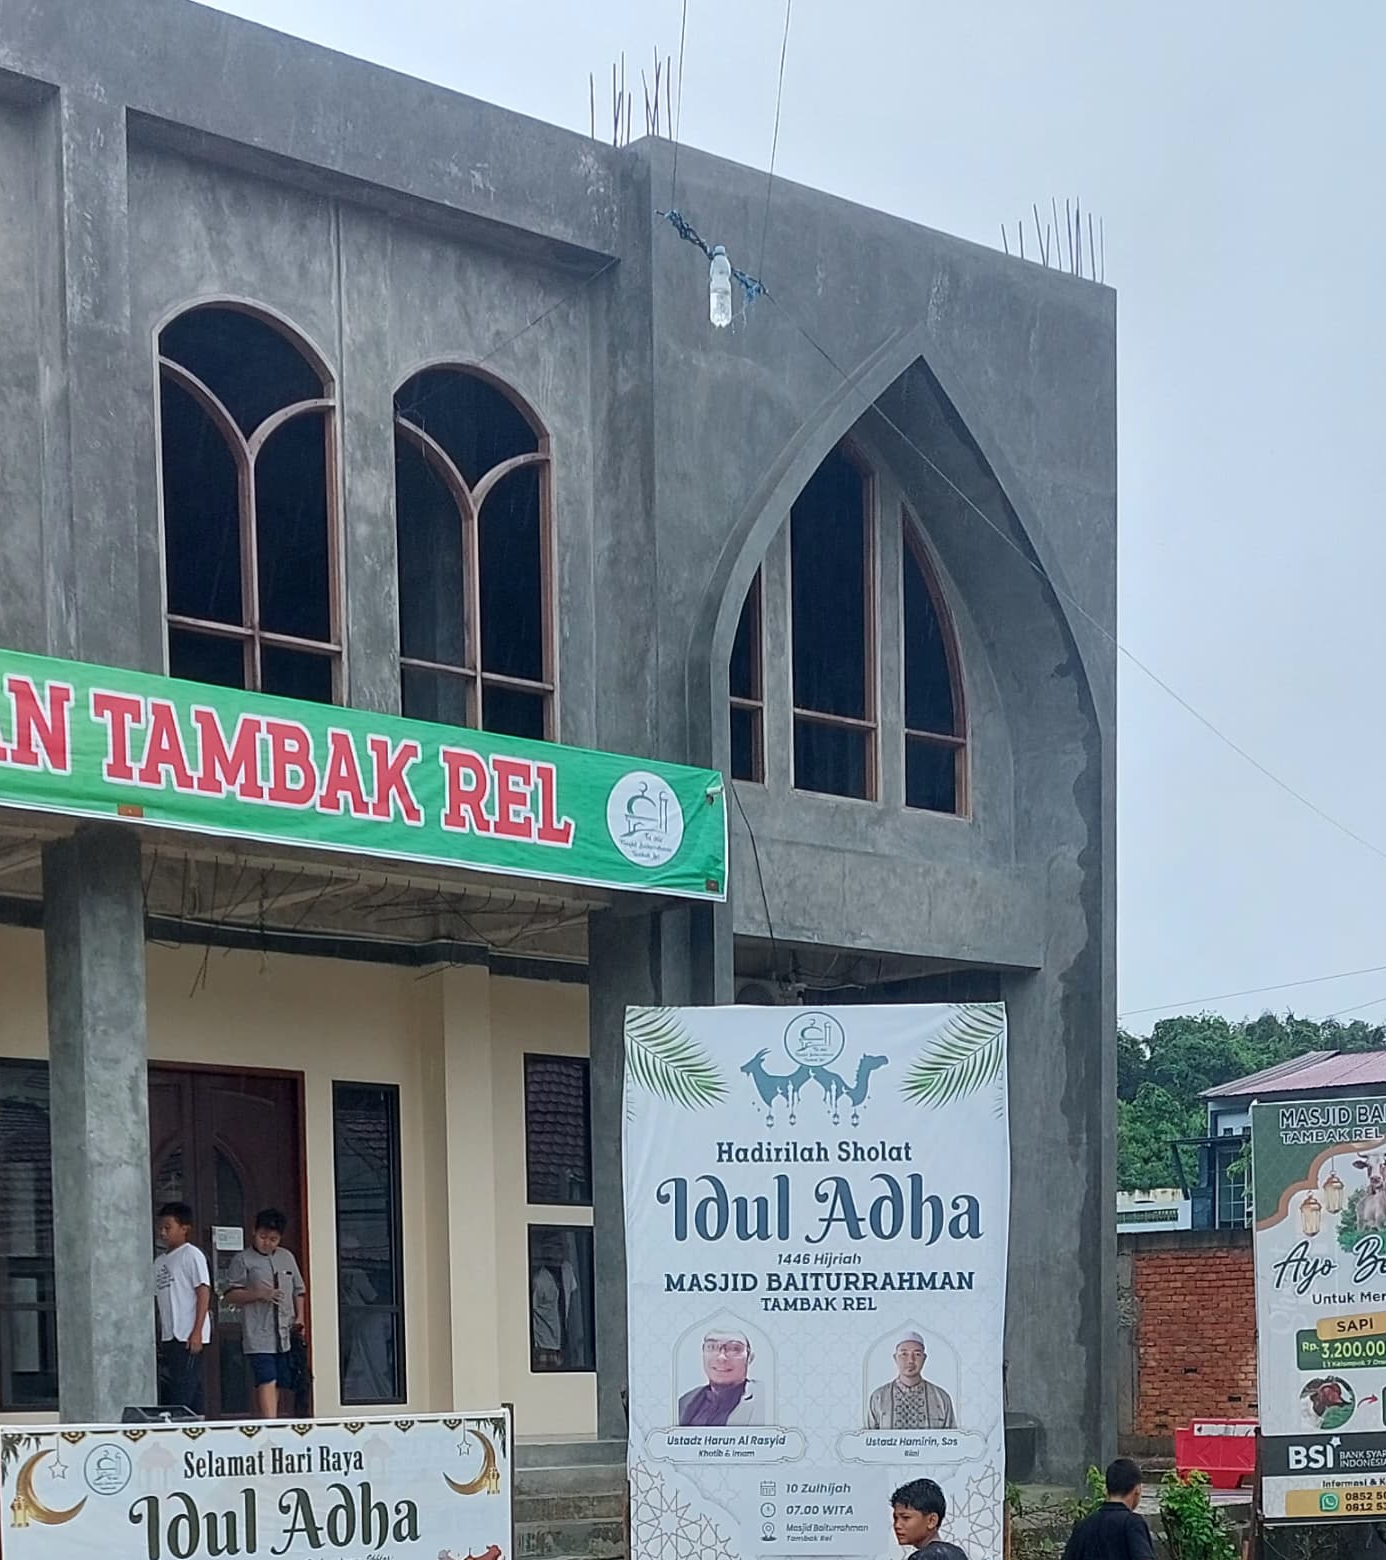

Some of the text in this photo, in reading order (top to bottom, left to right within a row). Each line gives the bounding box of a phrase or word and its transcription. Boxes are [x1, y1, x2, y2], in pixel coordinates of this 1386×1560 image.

[90, 688, 424, 827] TAMBAK
[439, 746, 574, 848] REL
[1280, 1107, 1351, 1129] MASJID
[1281, 1128, 1350, 1144] TAMBAK
[1353, 1127, 1384, 1140] REL
[716, 1141, 913, 1163] Hadirilah Sholat
[656, 1173, 985, 1246] Idul Adha
[777, 1253, 862, 1268] 1446 Hijriah
[1273, 1238, 1338, 1295] Ayo
[664, 1272, 975, 1292] MASJID BAITURRAHMAN
[761, 1297, 878, 1311] TAMBAK REL
[1313, 1292, 1356, 1305] Untuk
[1336, 1317, 1374, 1332] SAPI
[667, 1436, 702, 1446] Ustadz
[704, 1435, 736, 1445] Harun
[751, 1435, 786, 1448] Rasyid
[865, 1437, 898, 1446] Ustadz
[184, 1445, 364, 1479] Selamat Hari Raya
[1288, 1444, 1334, 1469] BSI
[1340, 1450, 1365, 1460] BANK
[786, 1483, 852, 1496] 10 Zulhijah
[1322, 1478, 1368, 1489] Informasi
[1369, 1478, 1378, 1486] &
[1345, 1492, 1374, 1501] 0852
[785, 1505, 855, 1515] 07.00 WITA
[1345, 1502, 1374, 1512] 0812
[128, 1482, 421, 1560] Idul Adha
[786, 1523, 813, 1535] Masjid
